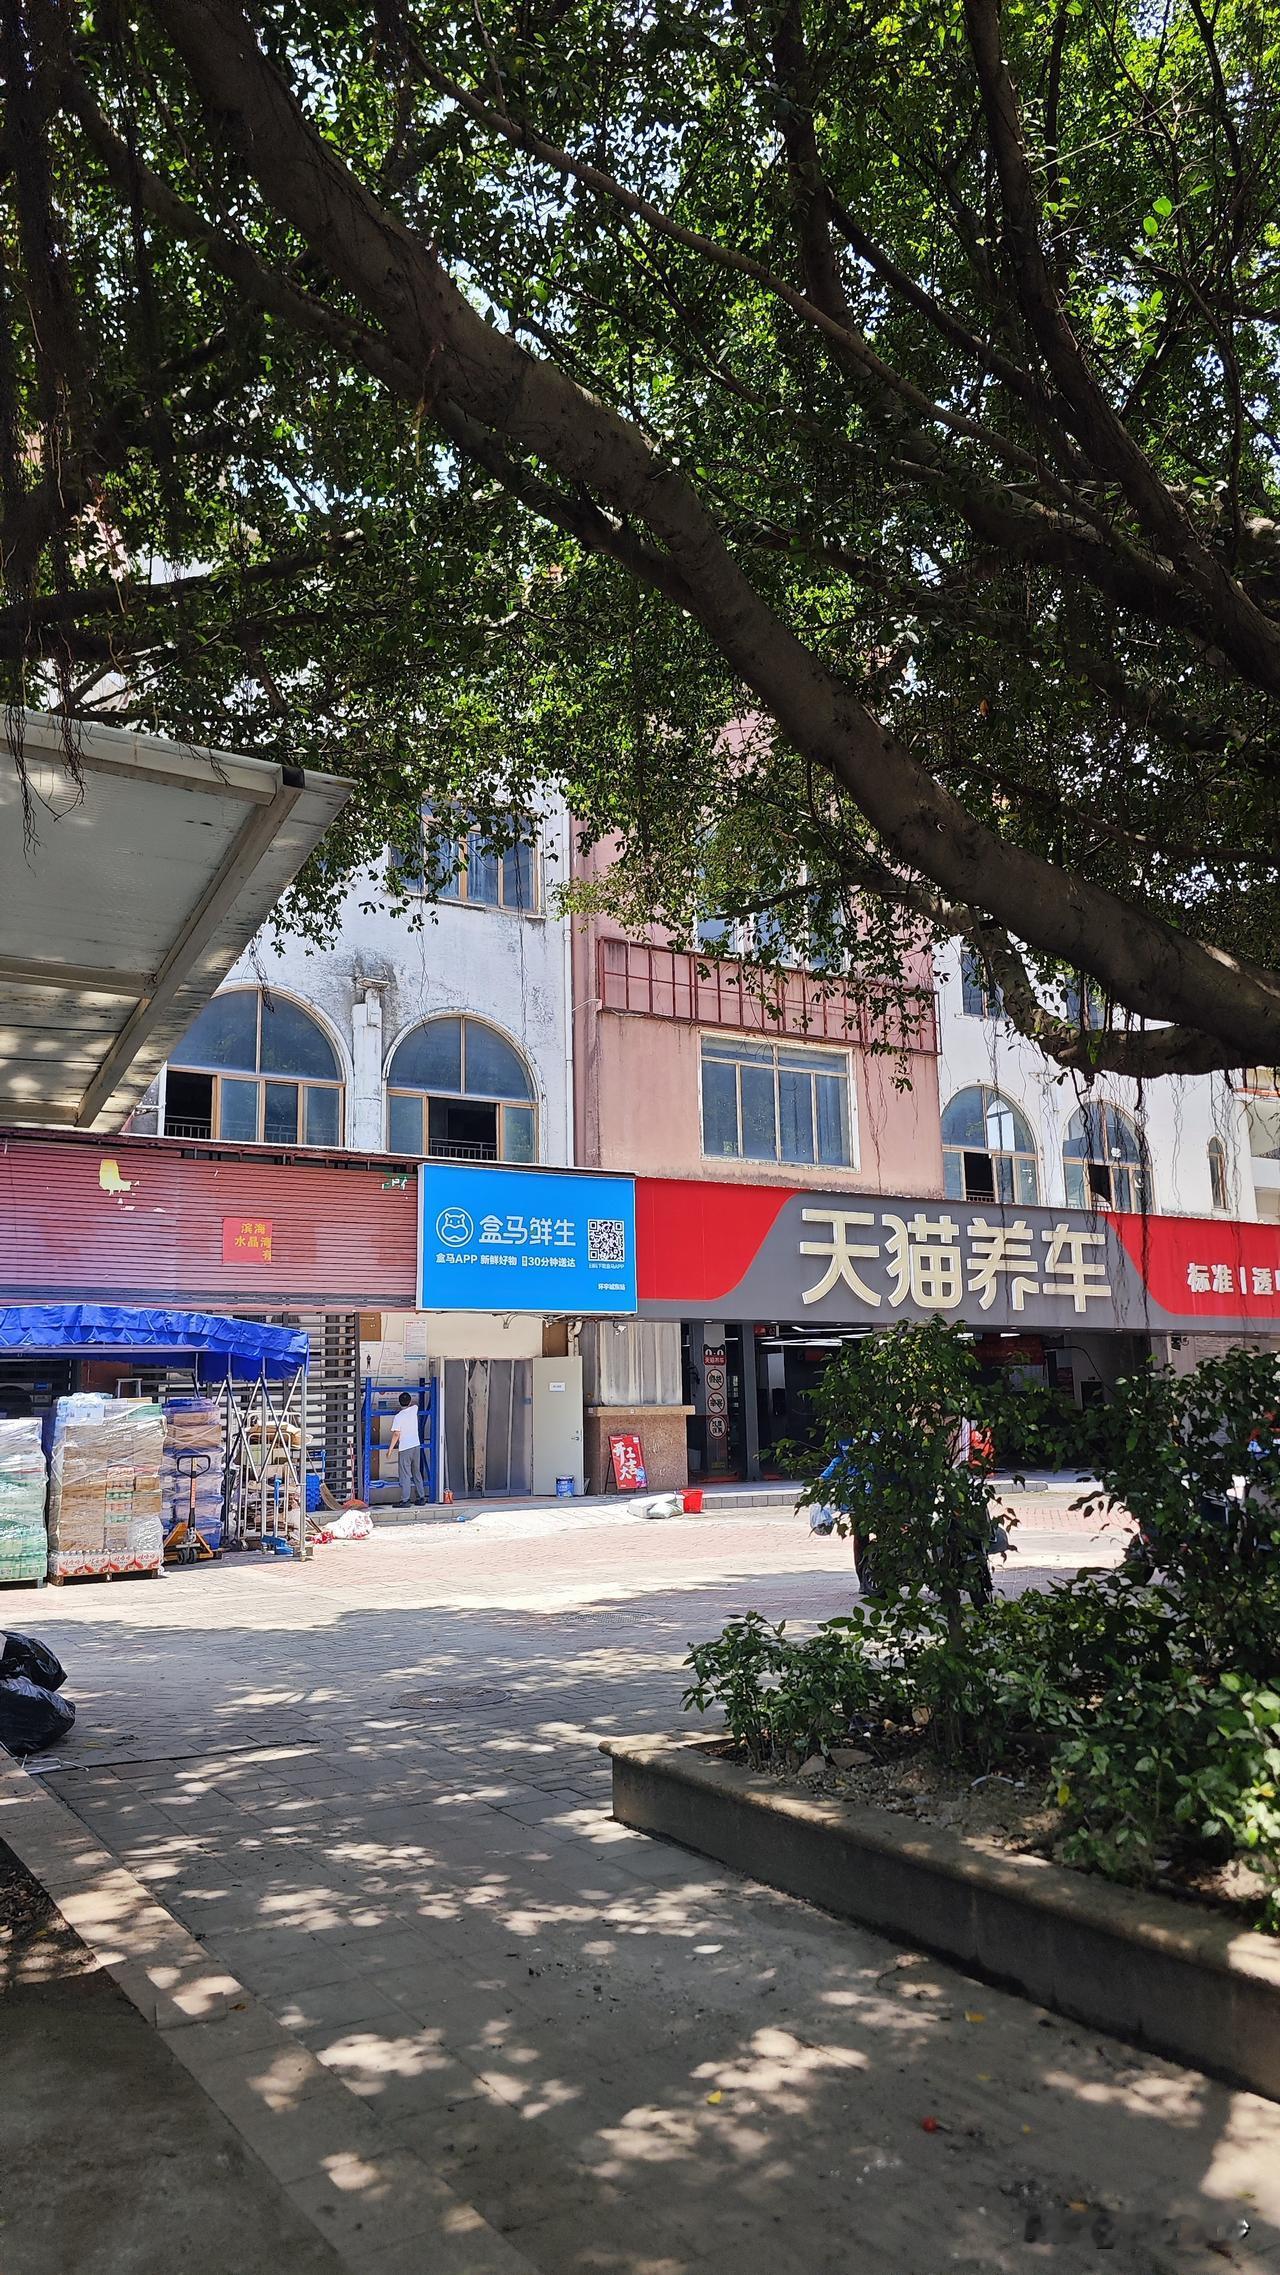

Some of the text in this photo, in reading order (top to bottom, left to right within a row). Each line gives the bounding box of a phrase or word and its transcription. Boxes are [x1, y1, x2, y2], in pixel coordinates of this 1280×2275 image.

[478, 1214, 577, 1247] 盒马鲜生
[435, 1252, 478, 1264] 盒马APP
[480, 1255, 518, 1266] 新鲜好物
[800, 1208, 1112, 1312] 天猫养车
